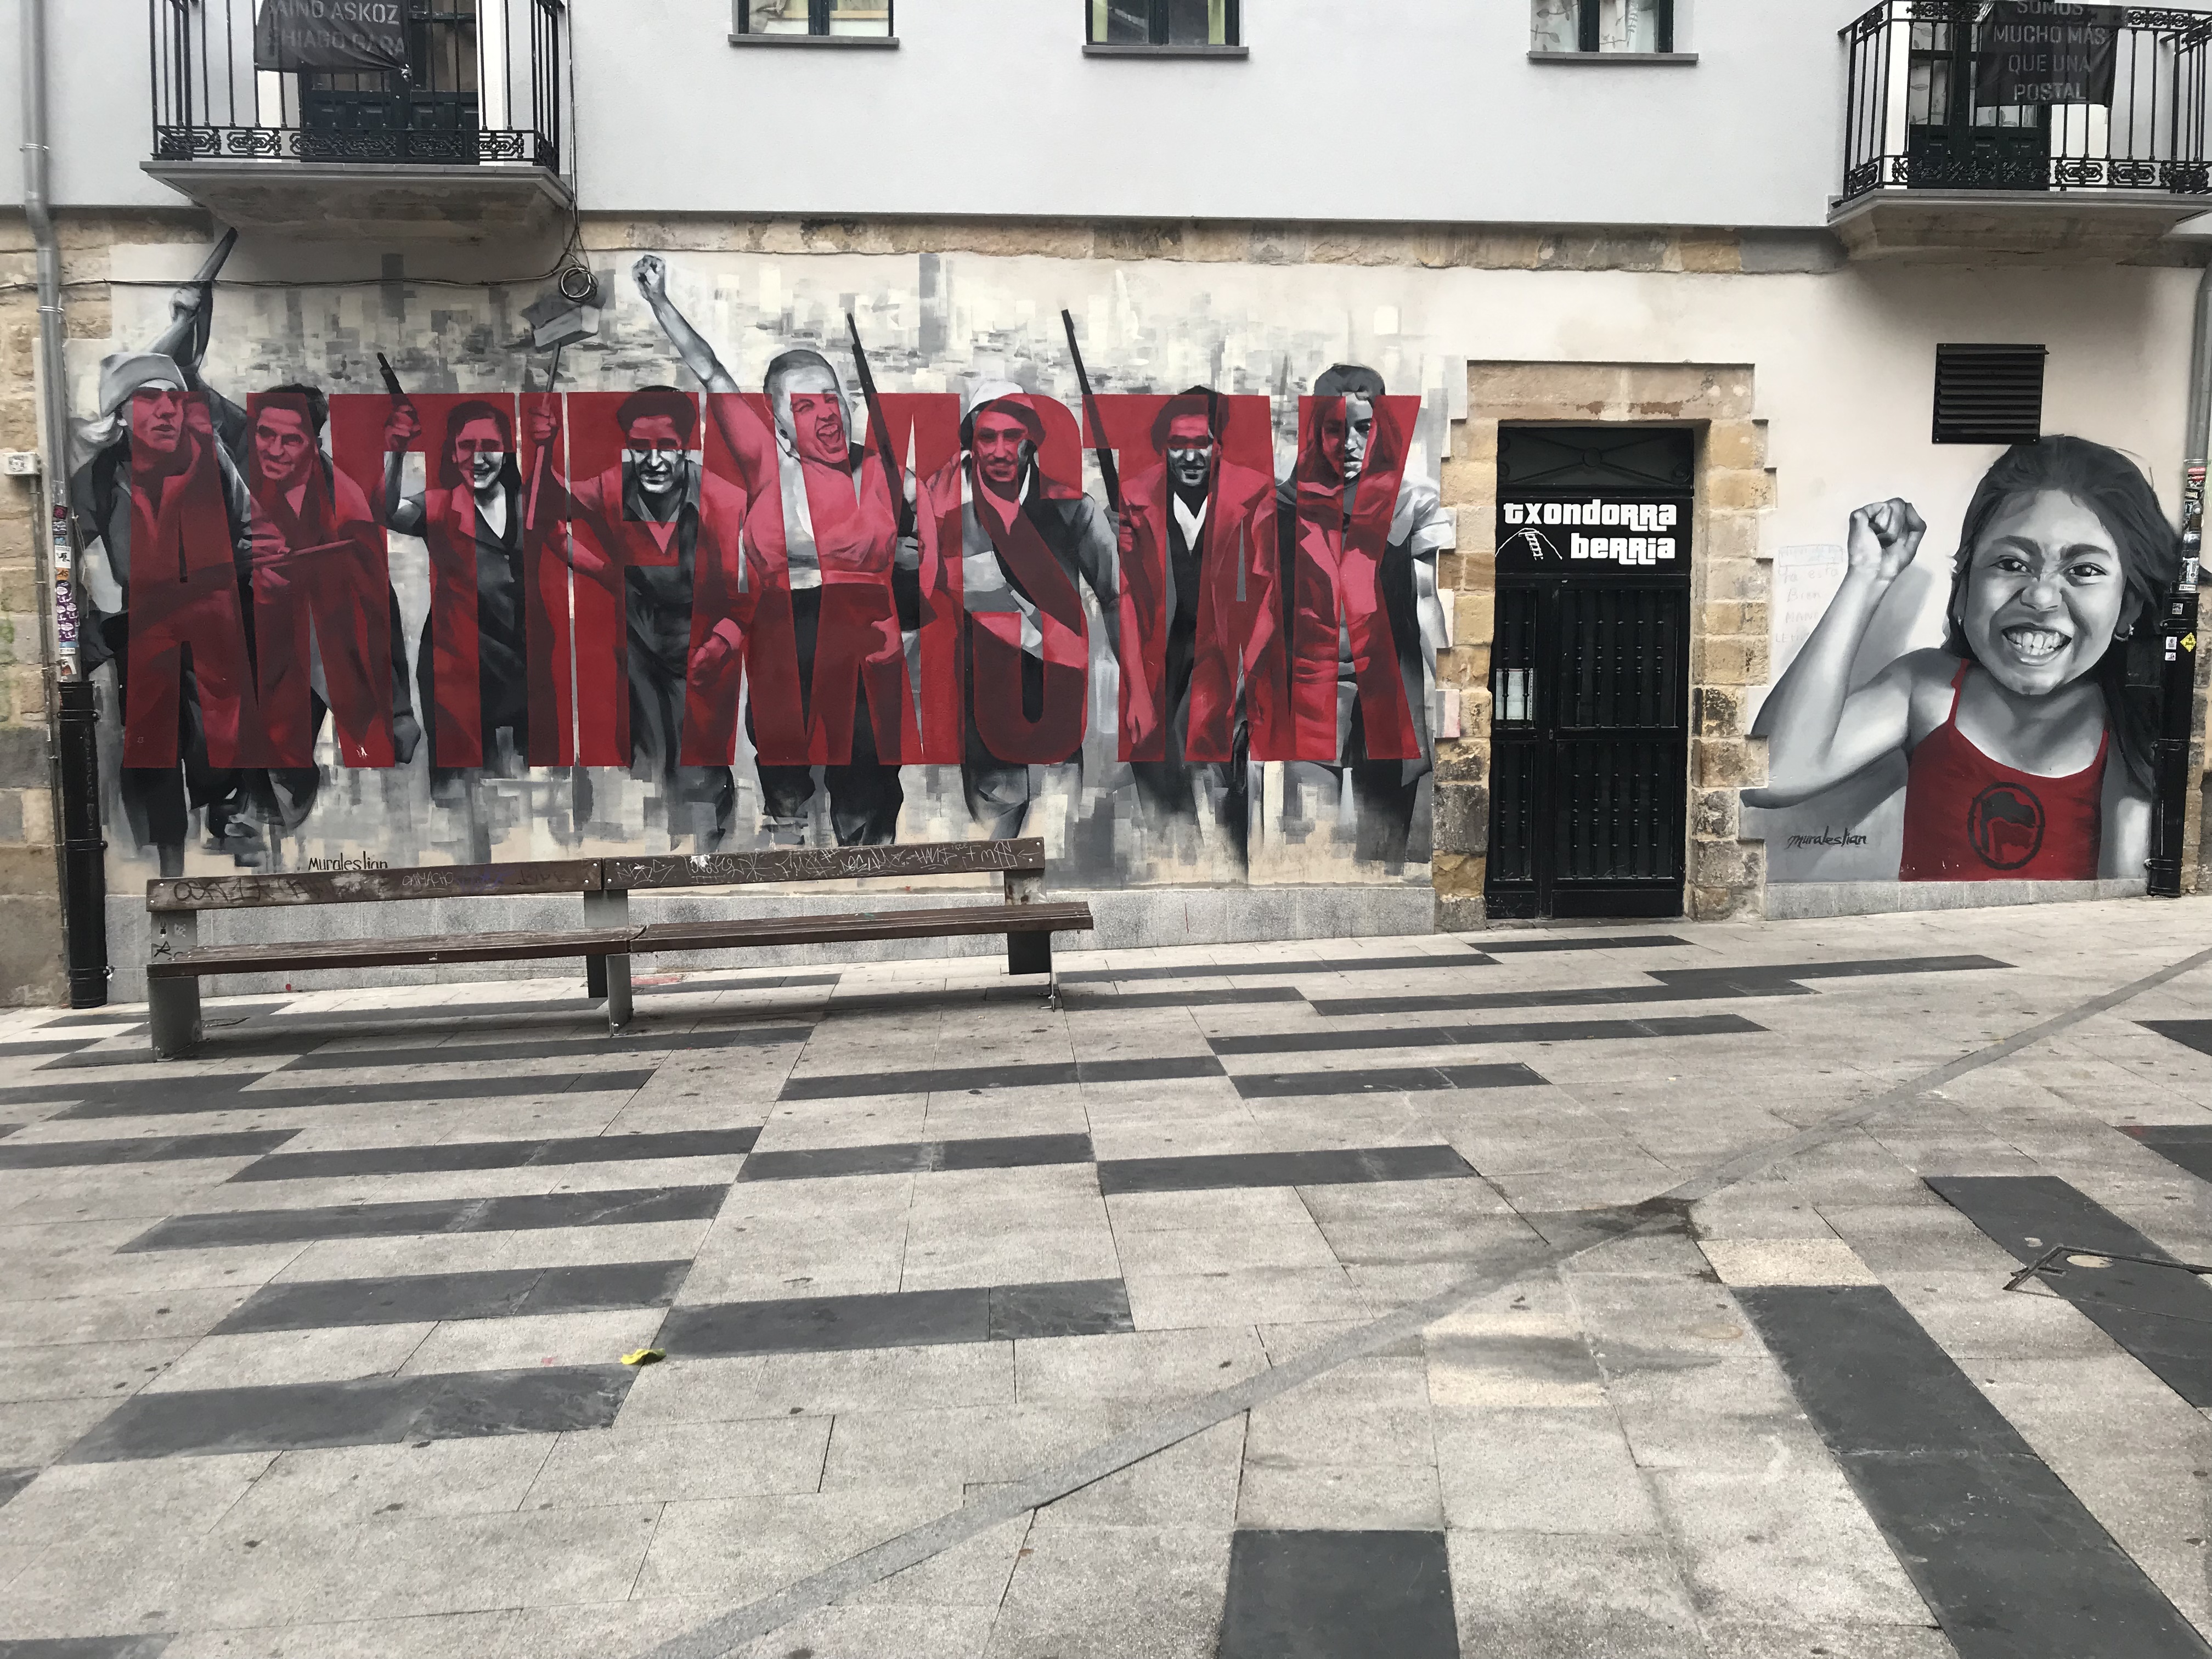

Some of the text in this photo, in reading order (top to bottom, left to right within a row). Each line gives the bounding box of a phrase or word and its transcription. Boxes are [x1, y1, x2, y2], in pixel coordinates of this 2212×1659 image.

[330, 2, 400, 25] ASKOZ
[2017, 0, 2084, 15] SOMOS
[1993, 25, 2062, 43] MUCHO
[2008, 54, 2095, 76] QUE UNA
[2013, 82, 2086, 101] POSTAL
